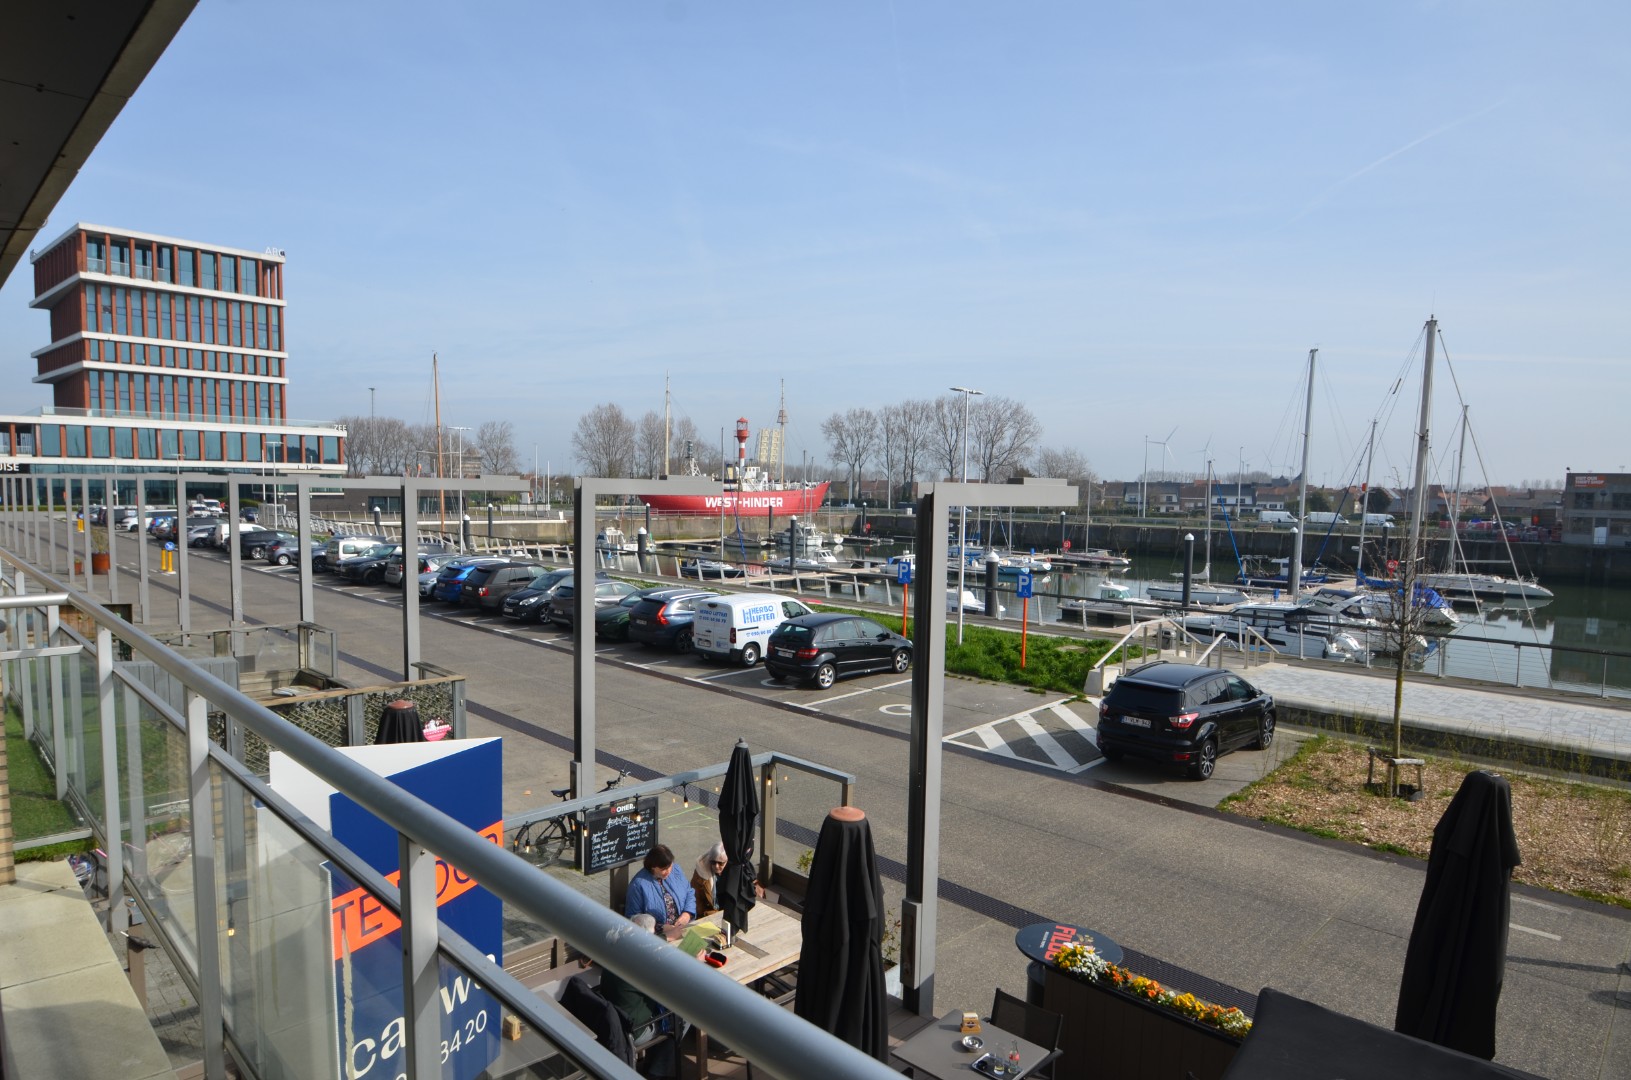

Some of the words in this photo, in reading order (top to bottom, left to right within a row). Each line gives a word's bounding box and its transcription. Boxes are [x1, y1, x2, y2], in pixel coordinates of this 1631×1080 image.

[705, 497, 783, 508] WEST-HINDER
[899, 563, 908, 579] P
[1018, 575, 1029, 592] P
[751, 605, 773, 614] HERBO
[753, 613, 775, 623] LIFTEN
[332, 893, 383, 942] TE
